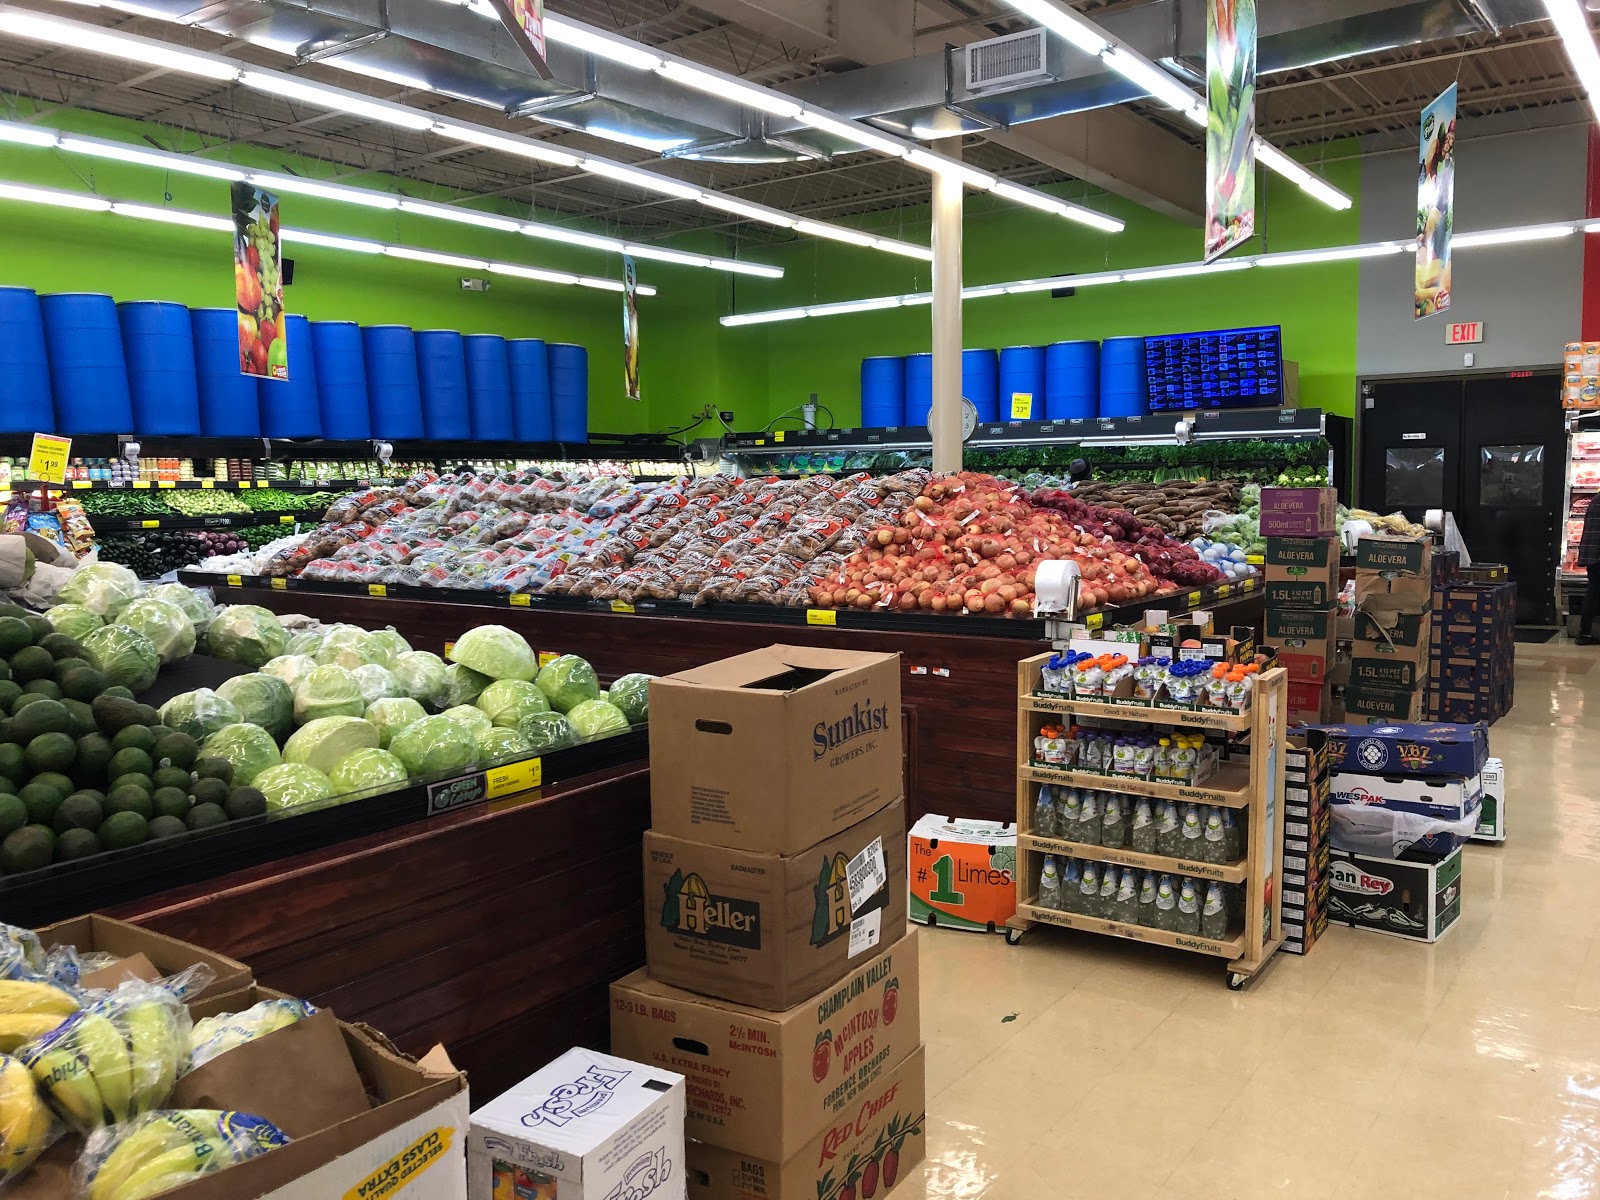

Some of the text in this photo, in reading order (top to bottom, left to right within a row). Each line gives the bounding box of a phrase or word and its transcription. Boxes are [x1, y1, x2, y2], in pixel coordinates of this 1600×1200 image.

[1452, 323, 1477, 342] EXIT
[1268, 520, 1289, 529] 500ml
[1278, 550, 1314, 560] ALOEVERA
[1368, 553, 1407, 565] ALOEVERA
[1271, 590, 1291, 600] 1.5L
[1278, 626, 1314, 635] ALOEVERA
[1358, 666, 1378, 678] 1.5L
[1033, 701, 1075, 712] BuddyFruits
[1356, 699, 1395, 712] ALOEVERA
[812, 698, 889, 762] Sunkist
[830, 740, 878, 768] GROWERS, INC.
[450, 778, 477, 793] GREEN
[492, 775, 509, 785] FRESH
[1032, 770, 1074, 782] BuddyFruits
[1178, 788, 1226, 802] BuddyFruits
[1336, 791, 1384, 804] WESPAK
[914, 843, 932, 856] The
[1032, 840, 1074, 853] BuddyFruits
[1178, 862, 1225, 878] BuddyFruits
[730, 864, 766, 875] BAGMASTER
[958, 859, 1011, 885] Limes
[1360, 874, 1392, 893] Rey
[677, 893, 756, 934] Heller
[1031, 910, 1072, 925] BuddyFruits
[1175, 937, 1222, 953] BuddyFruits
[817, 955, 892, 1025] CHAMPLAIN VALLEY
[652, 1007, 676, 1024] BAGS
[747, 1028, 770, 1044] MIN.
[843, 1034, 874, 1075] APPLES
[858, 1045, 891, 1079] ORCHARDS
[653, 1053, 731, 1079] U.S. EXTRA FANCY
[521, 1064, 632, 1127] Fresh
[358, 1131, 439, 1197] CLASS EXTRA
[401, 1142, 443, 1179] SELECTED
[516, 1142, 565, 1171] Fresh
[741, 1161, 765, 1177] BAGS
